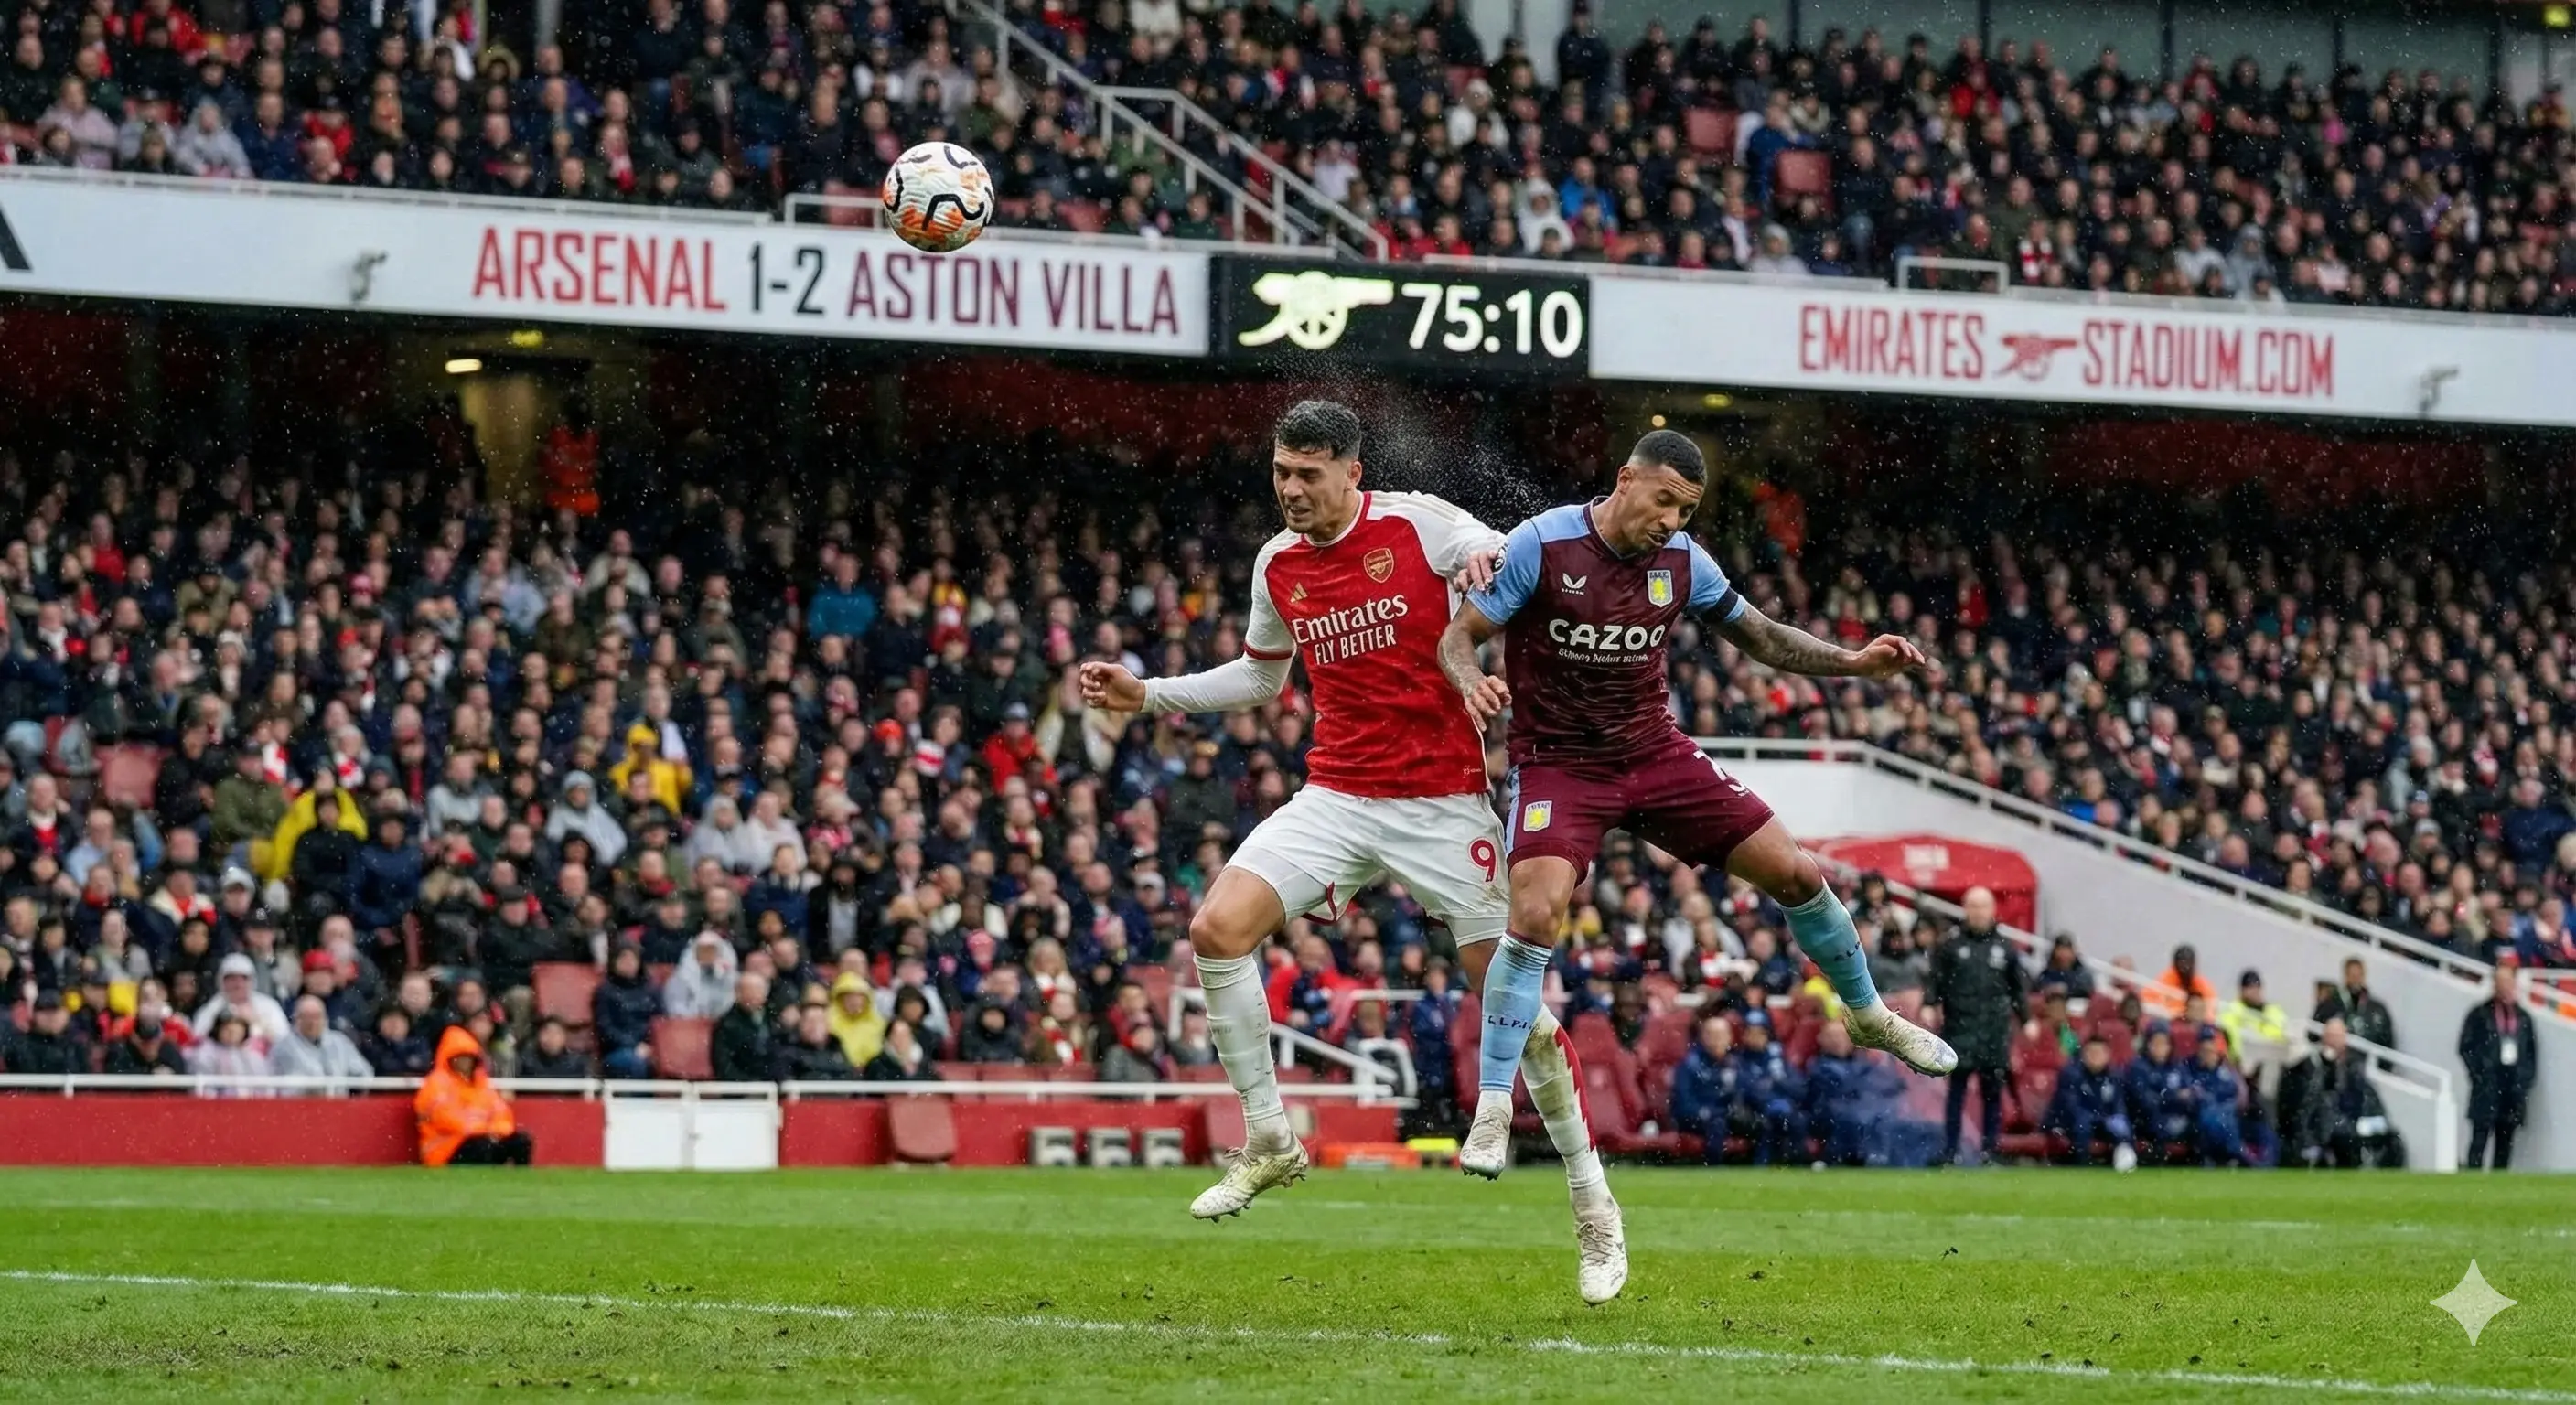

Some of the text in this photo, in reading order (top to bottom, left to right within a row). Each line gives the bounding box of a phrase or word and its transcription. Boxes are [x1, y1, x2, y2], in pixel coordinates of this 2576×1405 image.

[471, 226, 1180, 336] ARSENAL 1-2 ASTON VILLA
[1400, 281, 1584, 359] 75:10
[1799, 304, 2334, 397] EMIRATES STADIUM.COM
[1292, 595, 1408, 643] Emirates
[1549, 618, 1665, 650] CAZOO
[1315, 623, 1396, 665] FLY BETTER
[1469, 838, 1497, 882] 9
